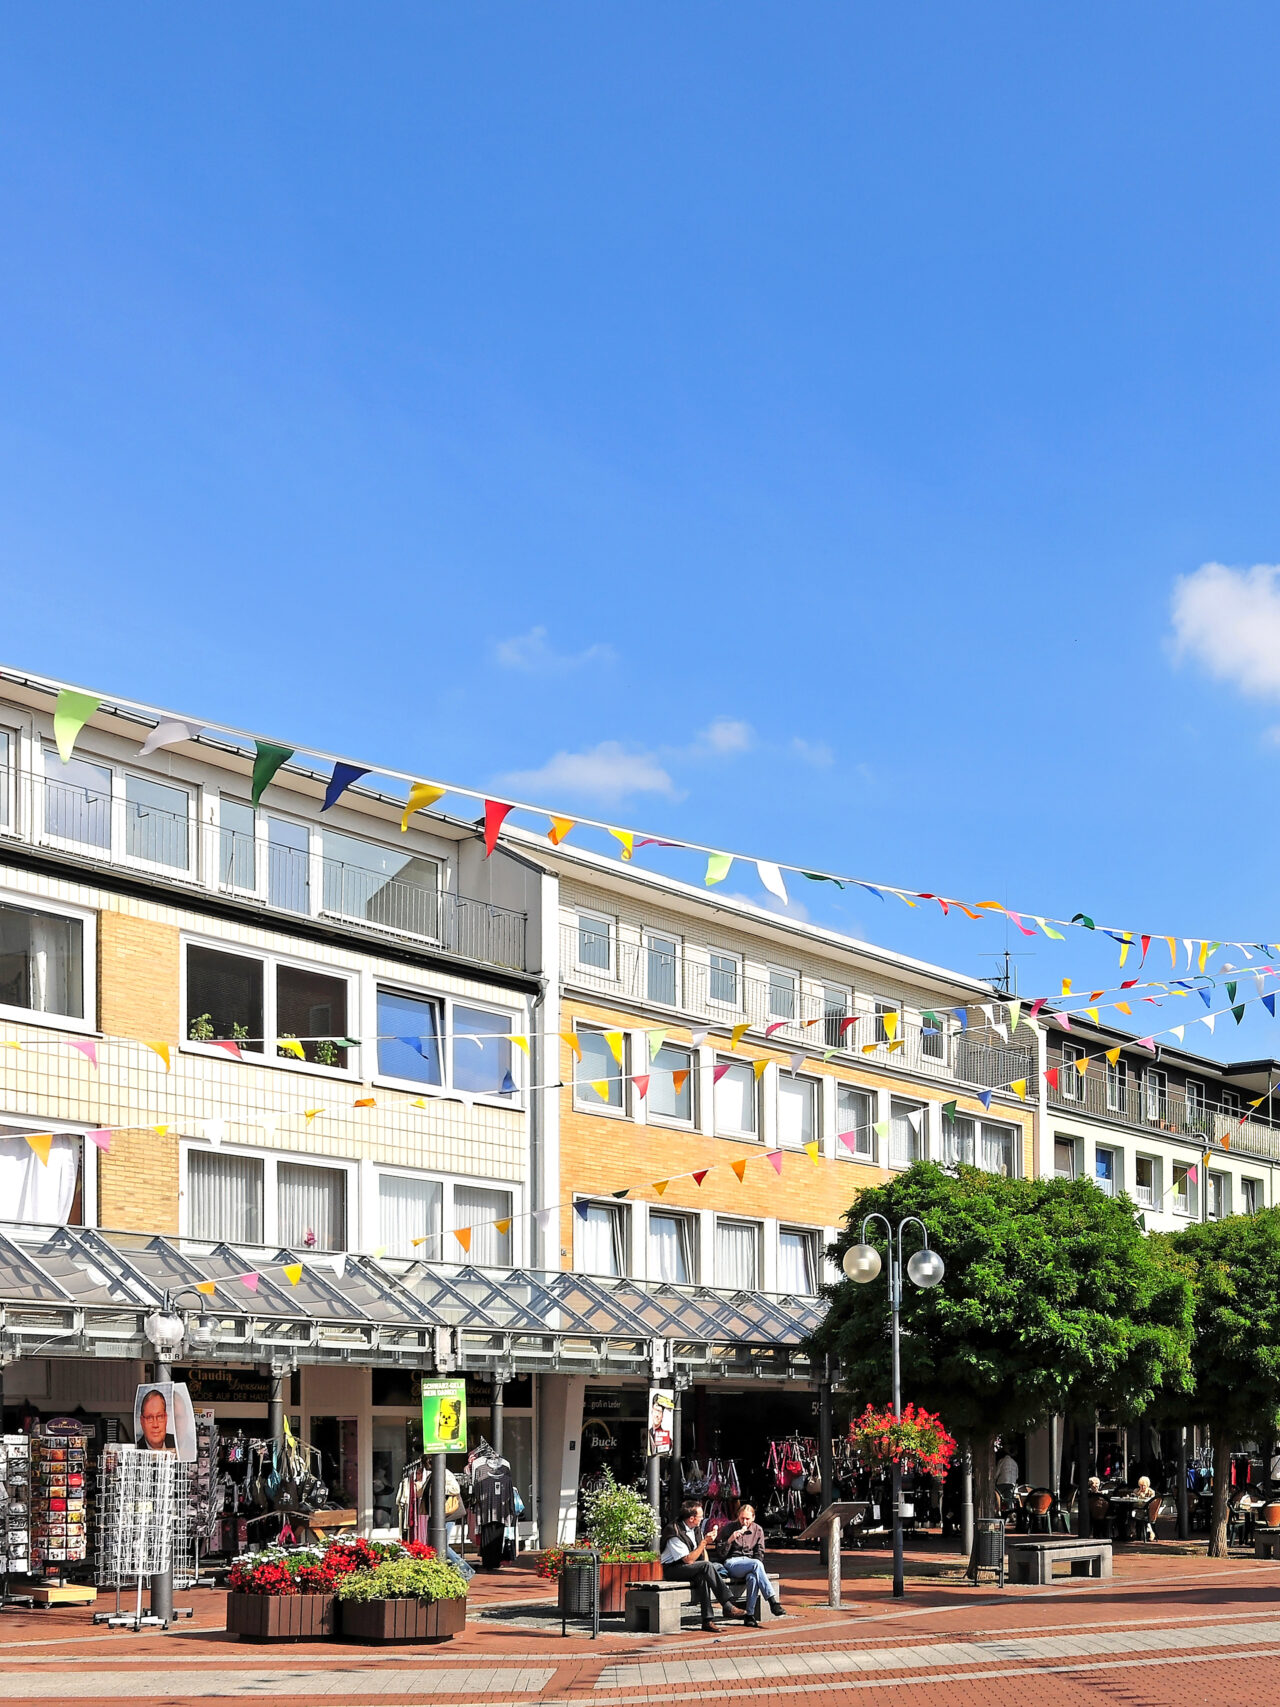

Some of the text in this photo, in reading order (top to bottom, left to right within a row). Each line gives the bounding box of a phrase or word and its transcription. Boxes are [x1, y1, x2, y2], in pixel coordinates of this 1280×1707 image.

[188, 1370, 232, 1381] Claudia
[49, 1423, 80, 1431] Hallmark
[591, 1437, 617, 1447] Buck
